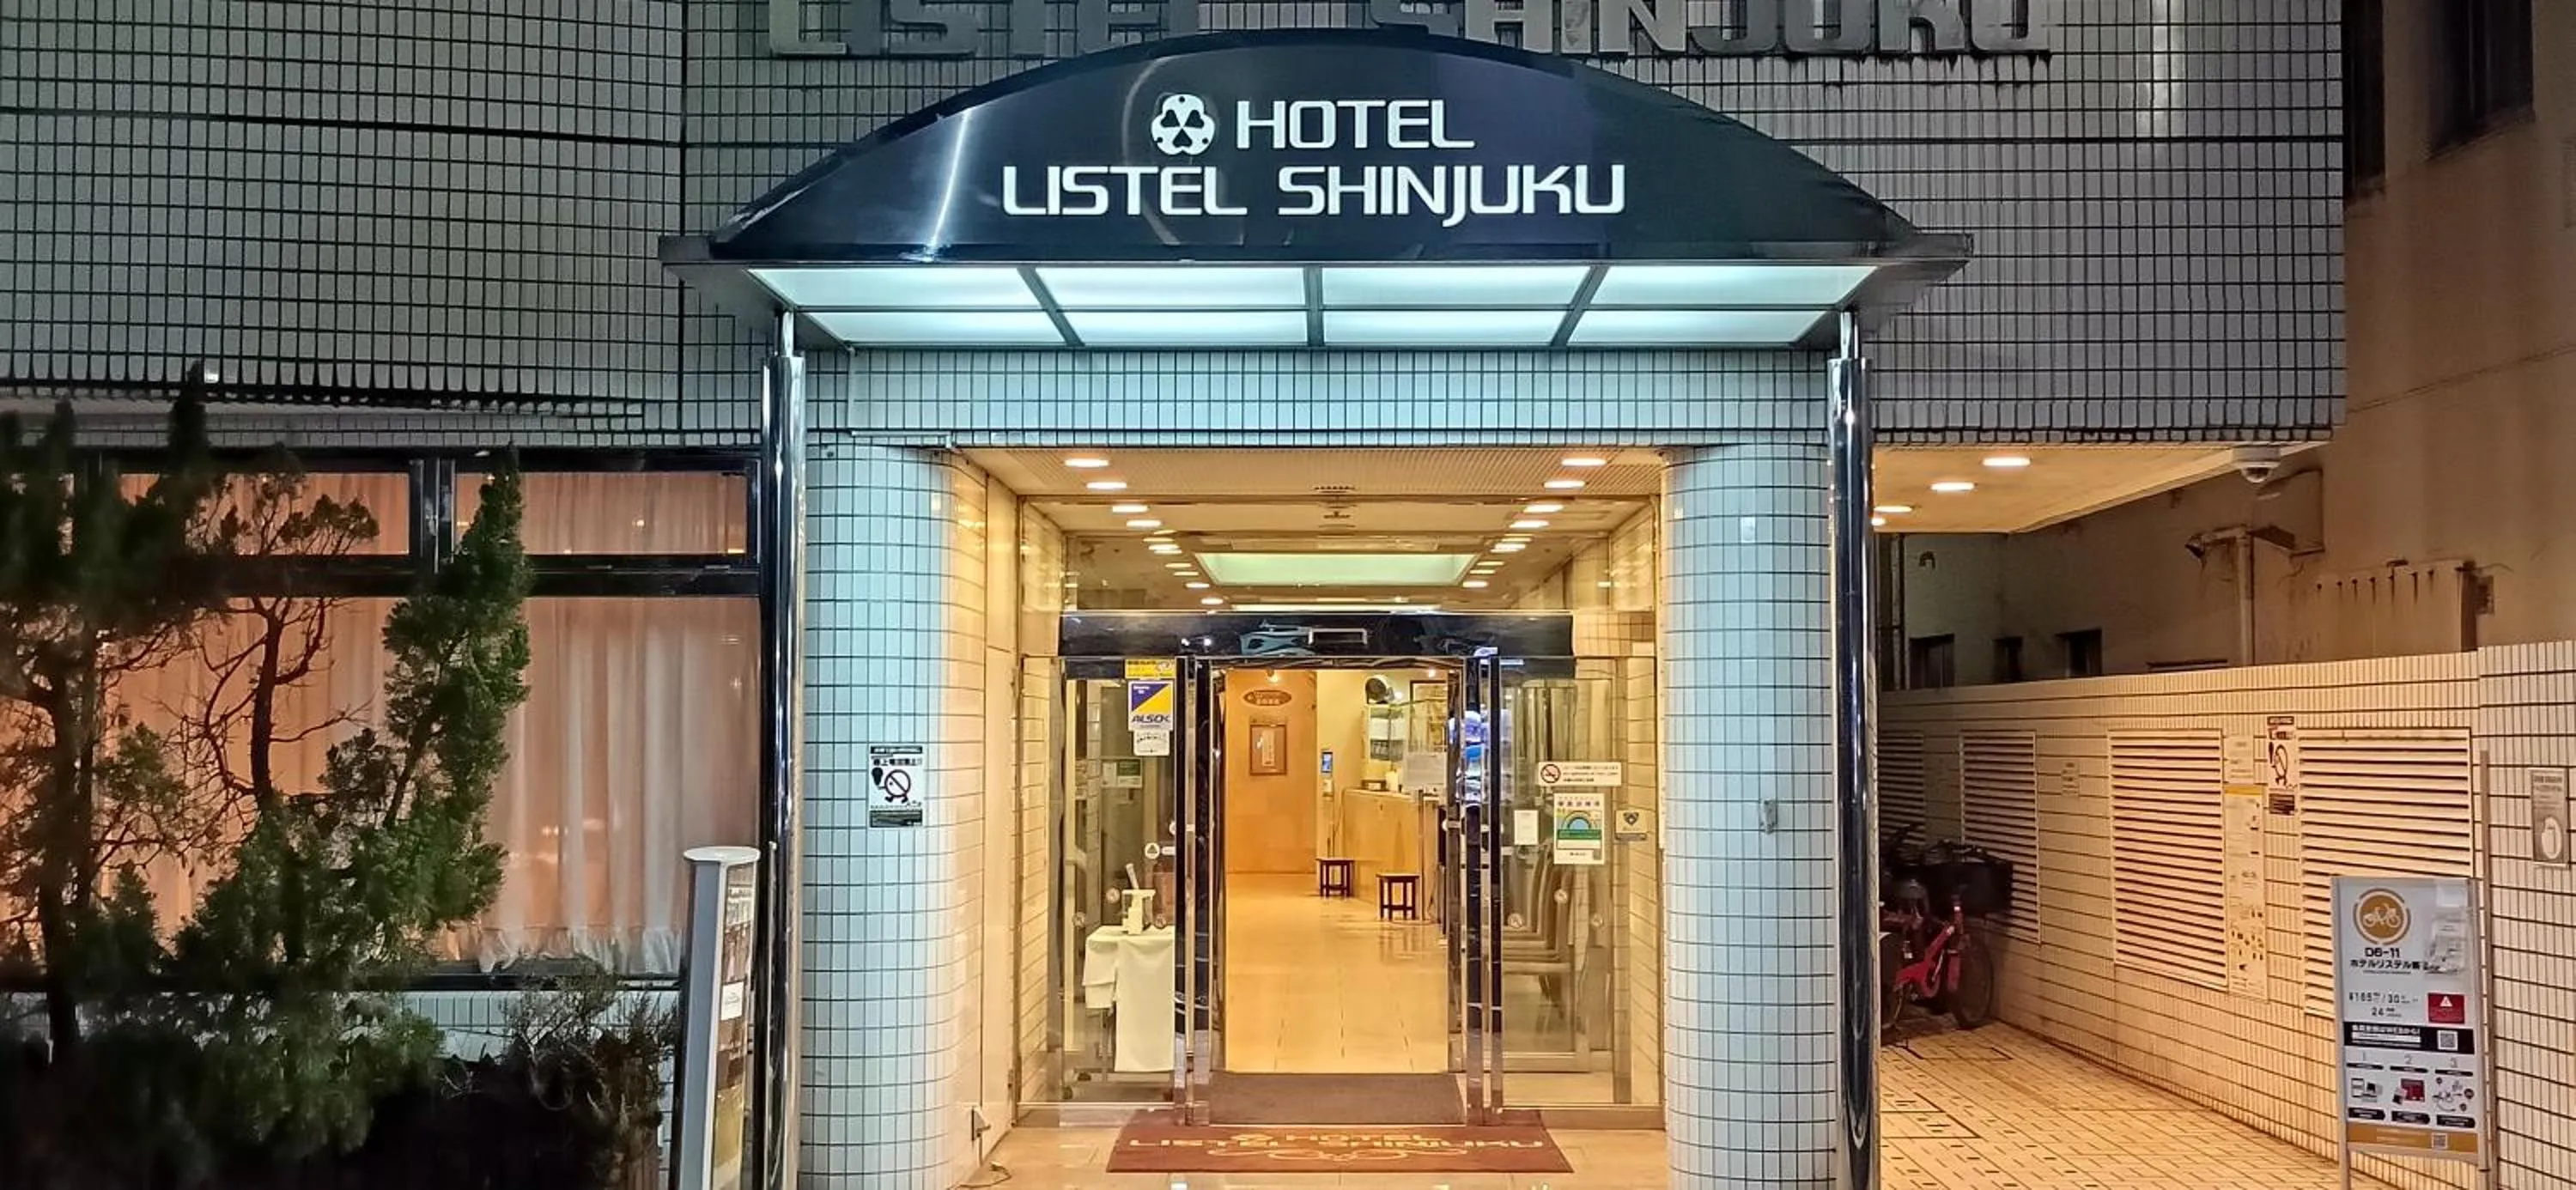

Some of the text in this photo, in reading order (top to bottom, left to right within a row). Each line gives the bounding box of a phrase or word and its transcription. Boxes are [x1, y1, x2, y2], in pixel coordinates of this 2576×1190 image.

[1236, 100, 1475, 149] HOTEL
[1003, 165, 1625, 228] LISTEL SHINJUKU
[1132, 713, 1170, 724] ALSOK
